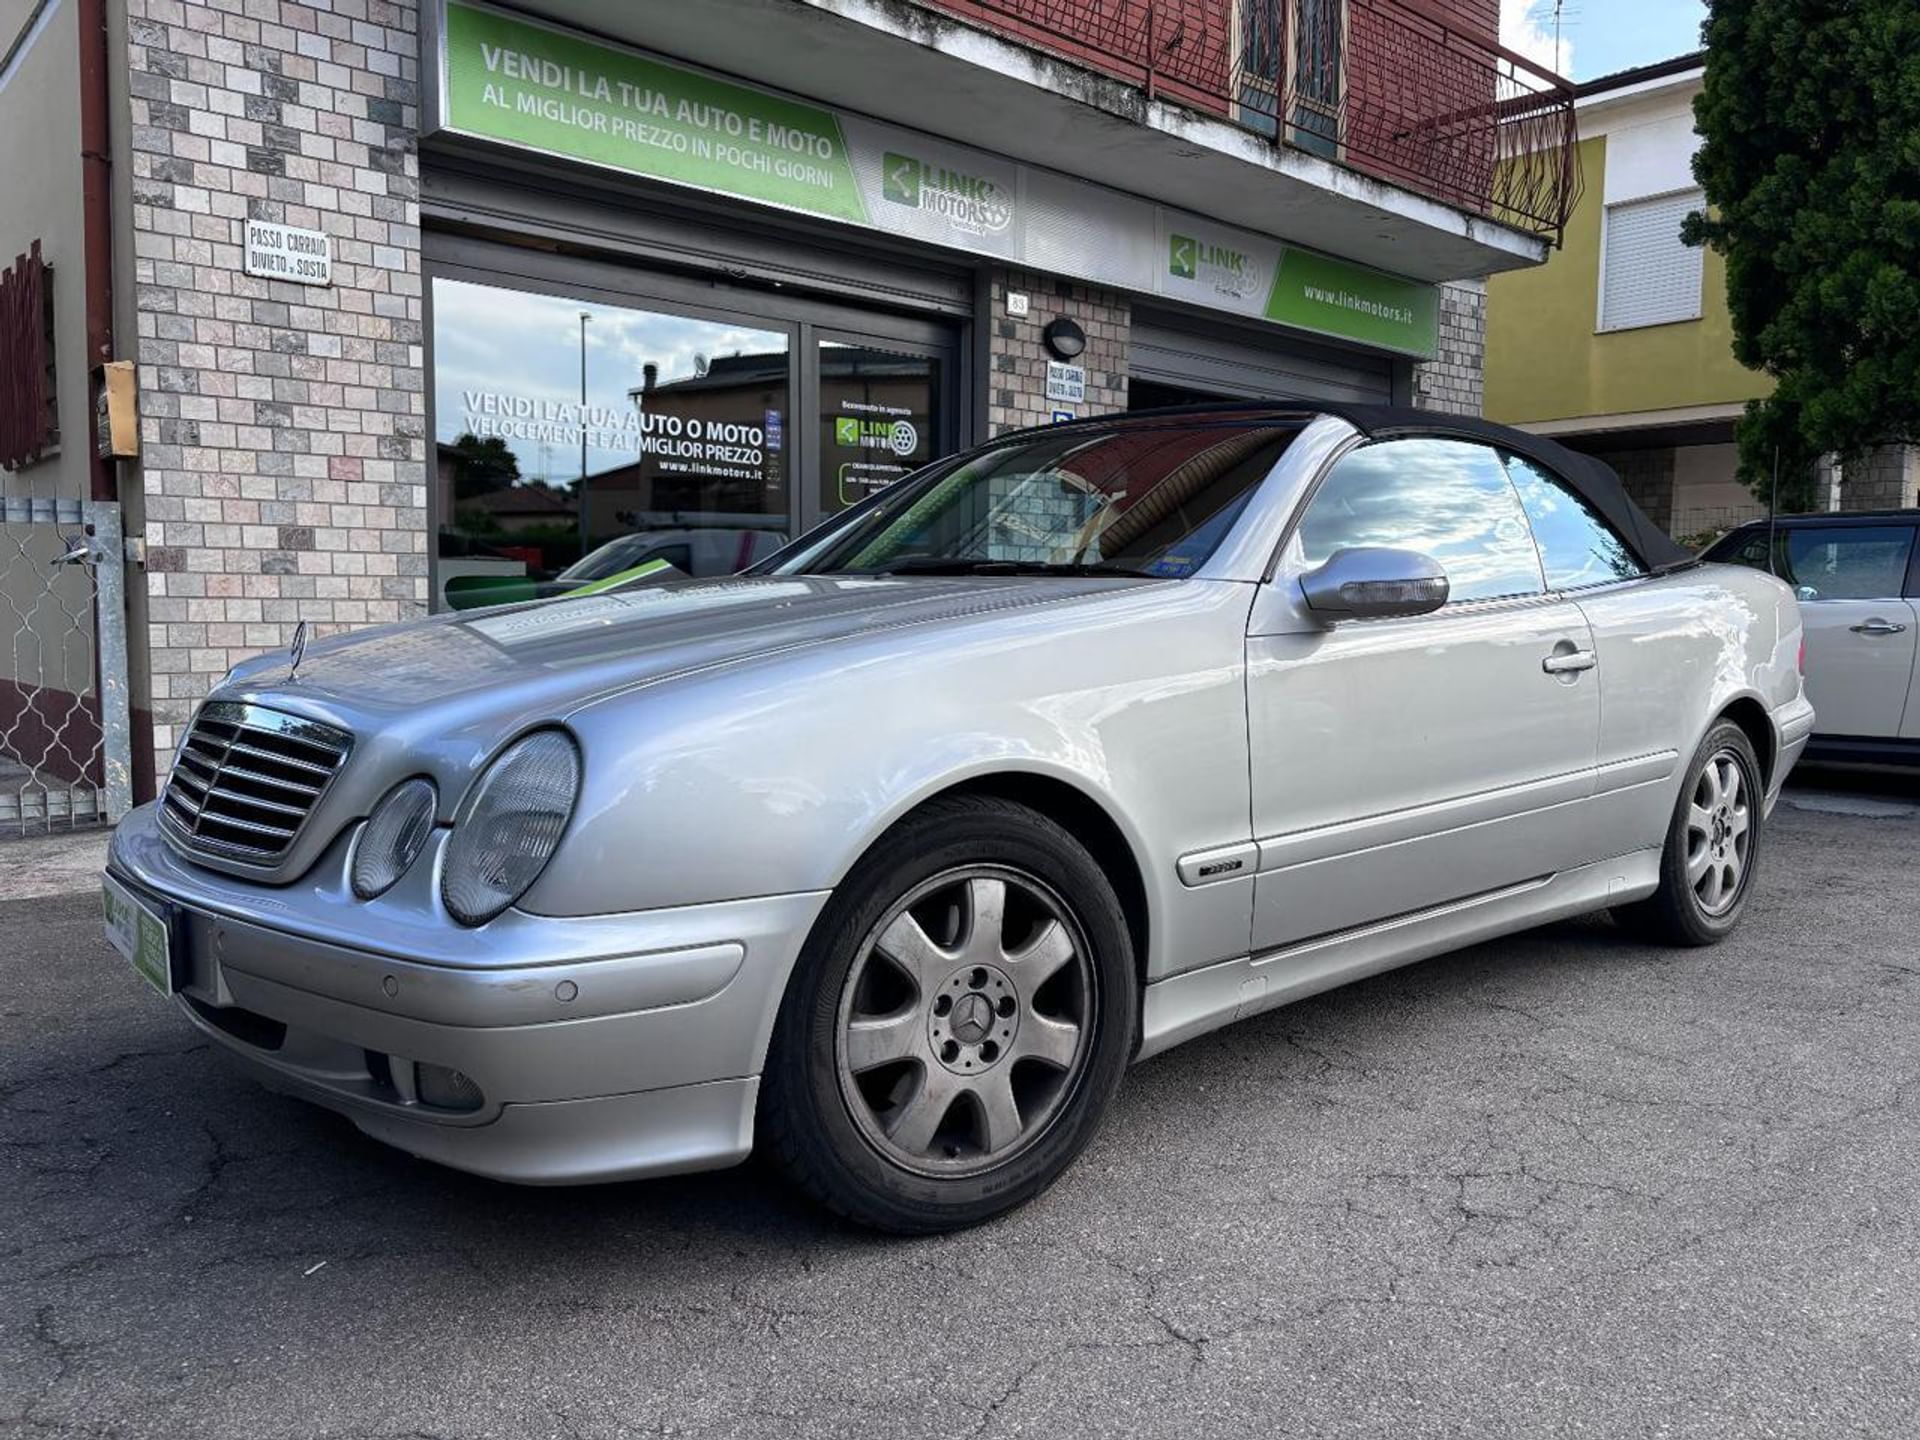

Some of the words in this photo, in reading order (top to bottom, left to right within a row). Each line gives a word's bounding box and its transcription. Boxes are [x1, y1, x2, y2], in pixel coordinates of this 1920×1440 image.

[480, 43, 571, 91] VENDI
[578, 70, 612, 103] LA
[617, 81, 670, 118] TUA
[676, 98, 742, 136] AUTO
[750, 117, 761, 142] E
[767, 123, 833, 160] MOTO
[482, 83, 511, 109] AL
[517, 92, 607, 133] MIGLIOR
[612, 115, 687, 153] PREZZO
[692, 137, 711, 159] IN
[716, 143, 771, 173] POCHI
[775, 159, 834, 189] GIORNI
[923, 163, 987, 203] LINK
[922, 189, 988, 224] MOTORS
[250, 226, 282, 249] PASSO
[287, 232, 327, 257] CARRAIO
[1199, 242, 1243, 274] LINK
[251, 250, 287, 273] DIVIETO
[297, 258, 327, 280] SOSTA
[1303, 284, 1413, 324] www.linkmotors.it
[463, 390, 537, 418] VENDI
[544, 399, 572, 422] LA
[574, 403, 620, 430] TUA
[624, 411, 682, 436] AUTO
[687, 419, 702, 438] O
[706, 421, 763, 446] MOTO
[465, 415, 595, 447] VELOCEMENTE
[598, 430, 609, 448] E
[611, 432, 633, 450] AL
[636, 435, 703, 459] MIGLIOR
[706, 444, 763, 466] PREZZO
[659, 460, 763, 480] www.linkmotors.it
